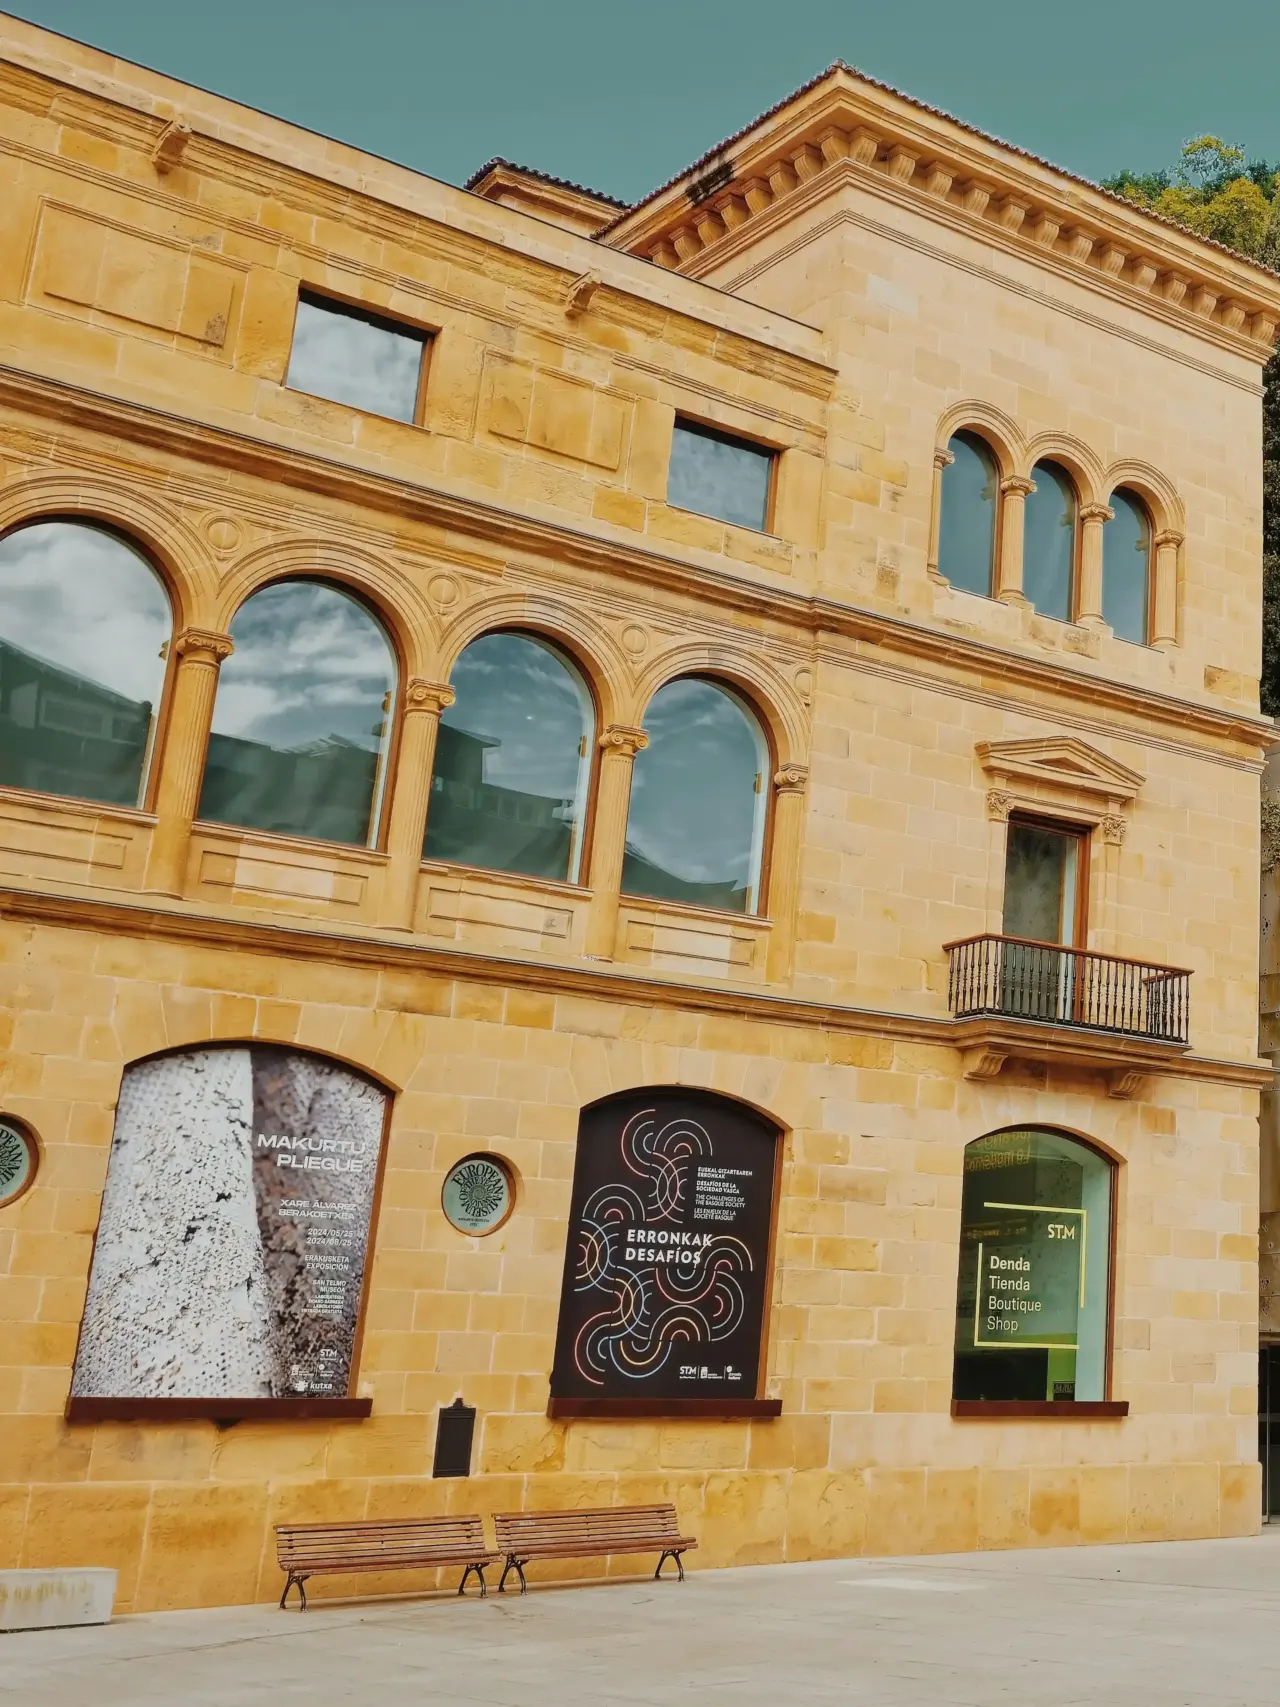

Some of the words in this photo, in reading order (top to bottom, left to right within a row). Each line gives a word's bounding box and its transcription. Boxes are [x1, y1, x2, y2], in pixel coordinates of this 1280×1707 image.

[257, 1133, 366, 1154] MAKURTU
[276, 1153, 364, 1173] PLIEGUE
[451, 1163, 504, 1195] EUROPEAN
[280, 1199, 310, 1208] XARE
[312, 1199, 357, 1211] ÁLVAREZ
[461, 1194, 503, 1217] MUSEUM
[705, 1194, 737, 1202] CHALLENGES
[278, 1208, 355, 1220] BERAKOETXEA
[307, 1228, 354, 1238] 2024/05/25
[626, 1229, 713, 1247] ERRONKAK
[1047, 1223, 1075, 1240] STM
[304, 1254, 350, 1263] ERAKUSKETA
[625, 1247, 701, 1265] DESAFÍOS
[990, 1255, 1031, 1271] Denda
[306, 1262, 349, 1271] EXPOSICIÓN
[988, 1275, 1030, 1291] Tienda
[988, 1295, 1042, 1314] Boutique
[986, 1315, 1019, 1334] Shop
[319, 1348, 338, 1357] STM
[680, 1365, 697, 1375] STM
[310, 1381, 333, 1390] kutxa
